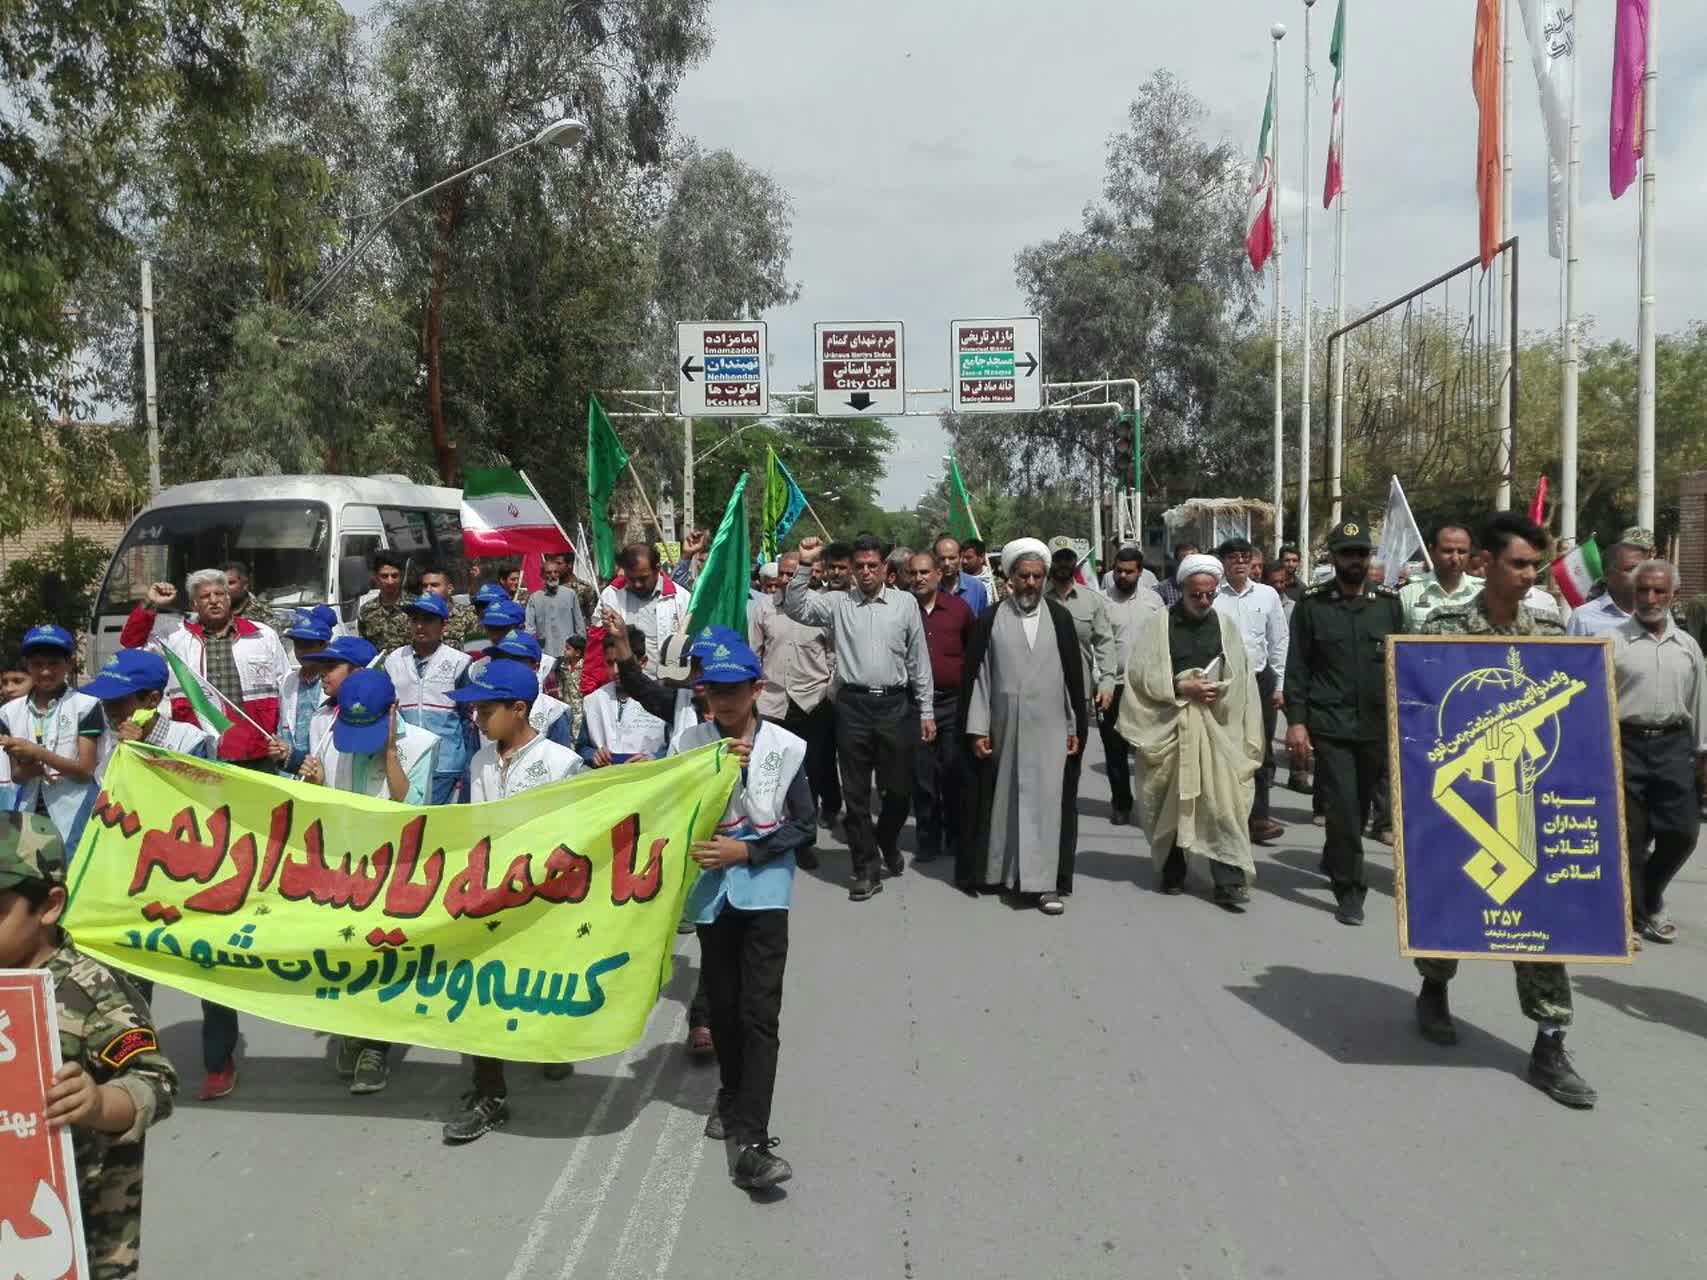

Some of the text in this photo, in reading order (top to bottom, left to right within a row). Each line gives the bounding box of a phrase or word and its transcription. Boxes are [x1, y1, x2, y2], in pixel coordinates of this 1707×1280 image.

[705, 332, 757, 347] امامزاده
[827, 333, 895, 349] حرم شهدای گمنام
[960, 329, 1013, 345] بازار تاریخی
[707, 357, 759, 371] نهبندان
[833, 360, 892, 378] شهر باستانی
[962, 354, 1013, 369] مسجد جامع
[725, 383, 758, 397] کلوت
[836, 378, 890, 390] City Old
[998, 380, 1014, 391] خانه
[1541, 791, 1596, 809] سپاه
[1543, 814, 1598, 838] پاسداران
[1543, 839, 1599, 859] انقلاب
[610, 812, 670, 906] ما
[443, 835, 593, 920] همه
[1545, 863, 1601, 884] اسلامی
[1483, 909, 1522, 926] ۱۳۵۷
[476, 952, 630, 1031] کسبه
